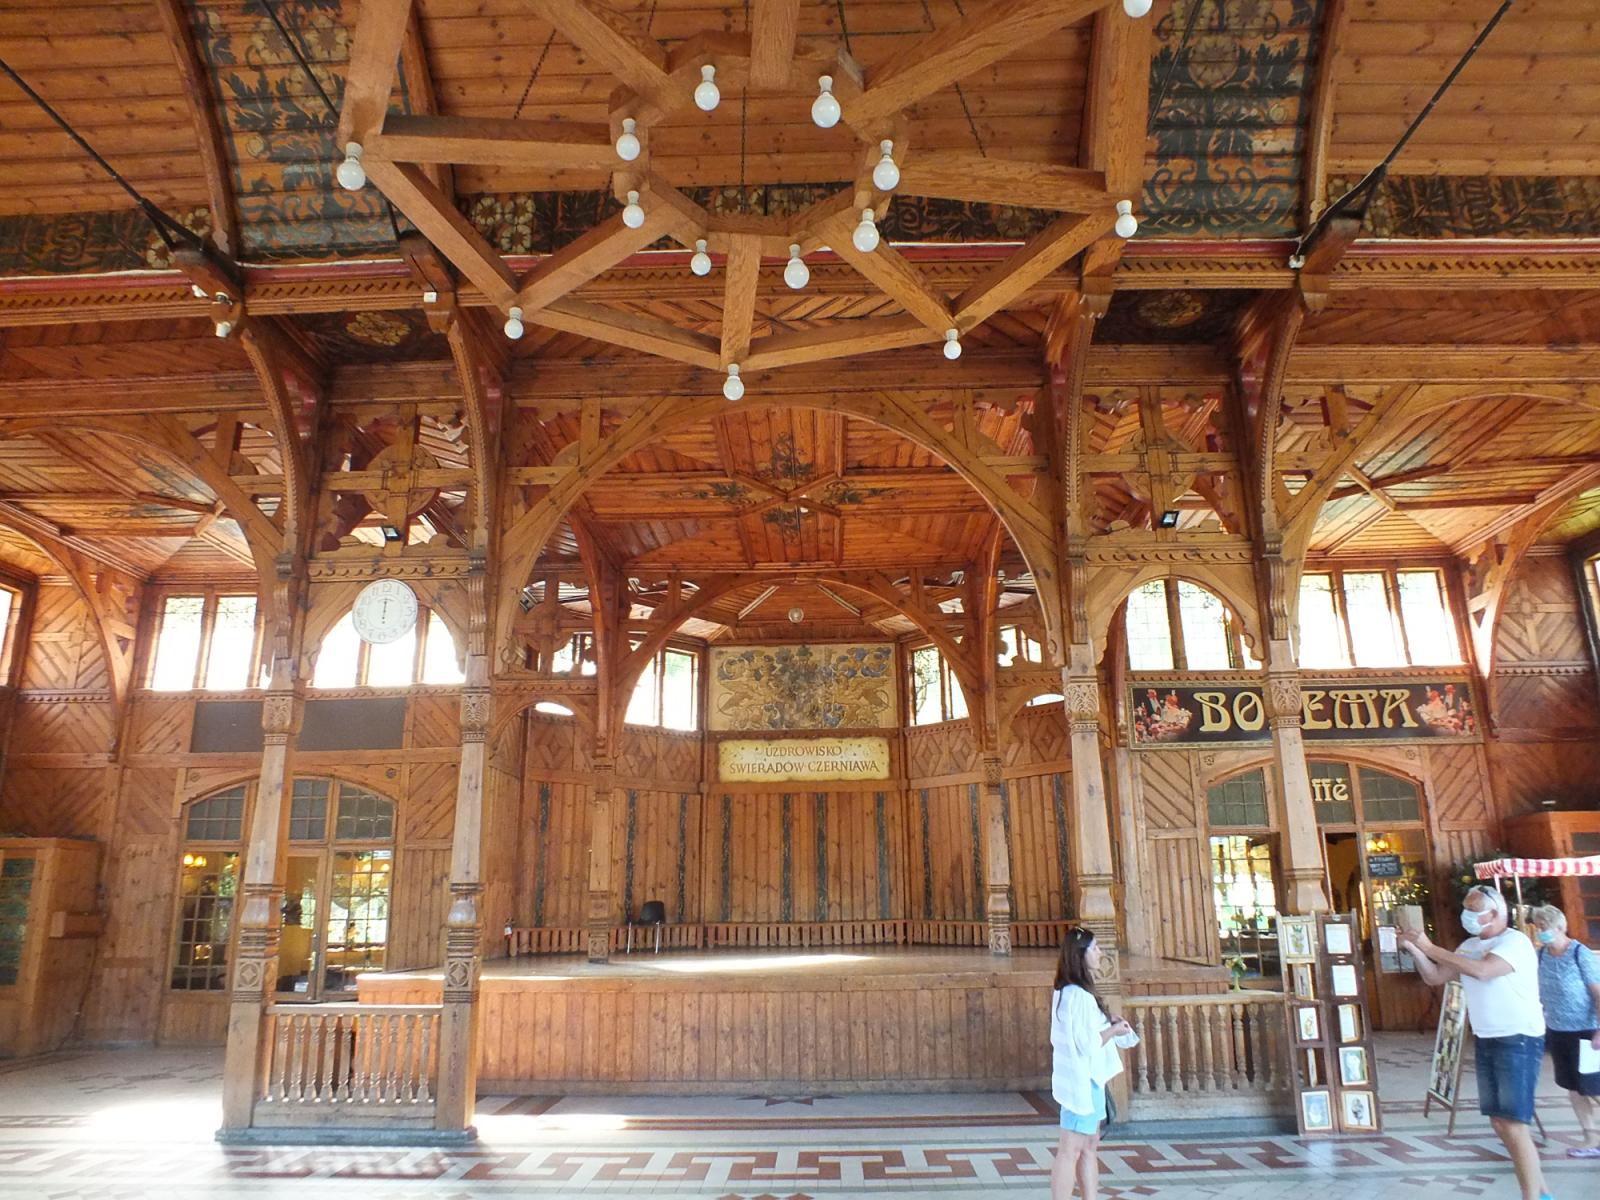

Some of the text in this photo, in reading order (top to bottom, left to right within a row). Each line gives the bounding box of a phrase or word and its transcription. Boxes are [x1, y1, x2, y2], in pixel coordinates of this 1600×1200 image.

[1193, 689, 1419, 732] BOEMA
[765, 746, 842, 757] UZDROWISKO
[807, 760, 880, 773] CZERNIAWA
